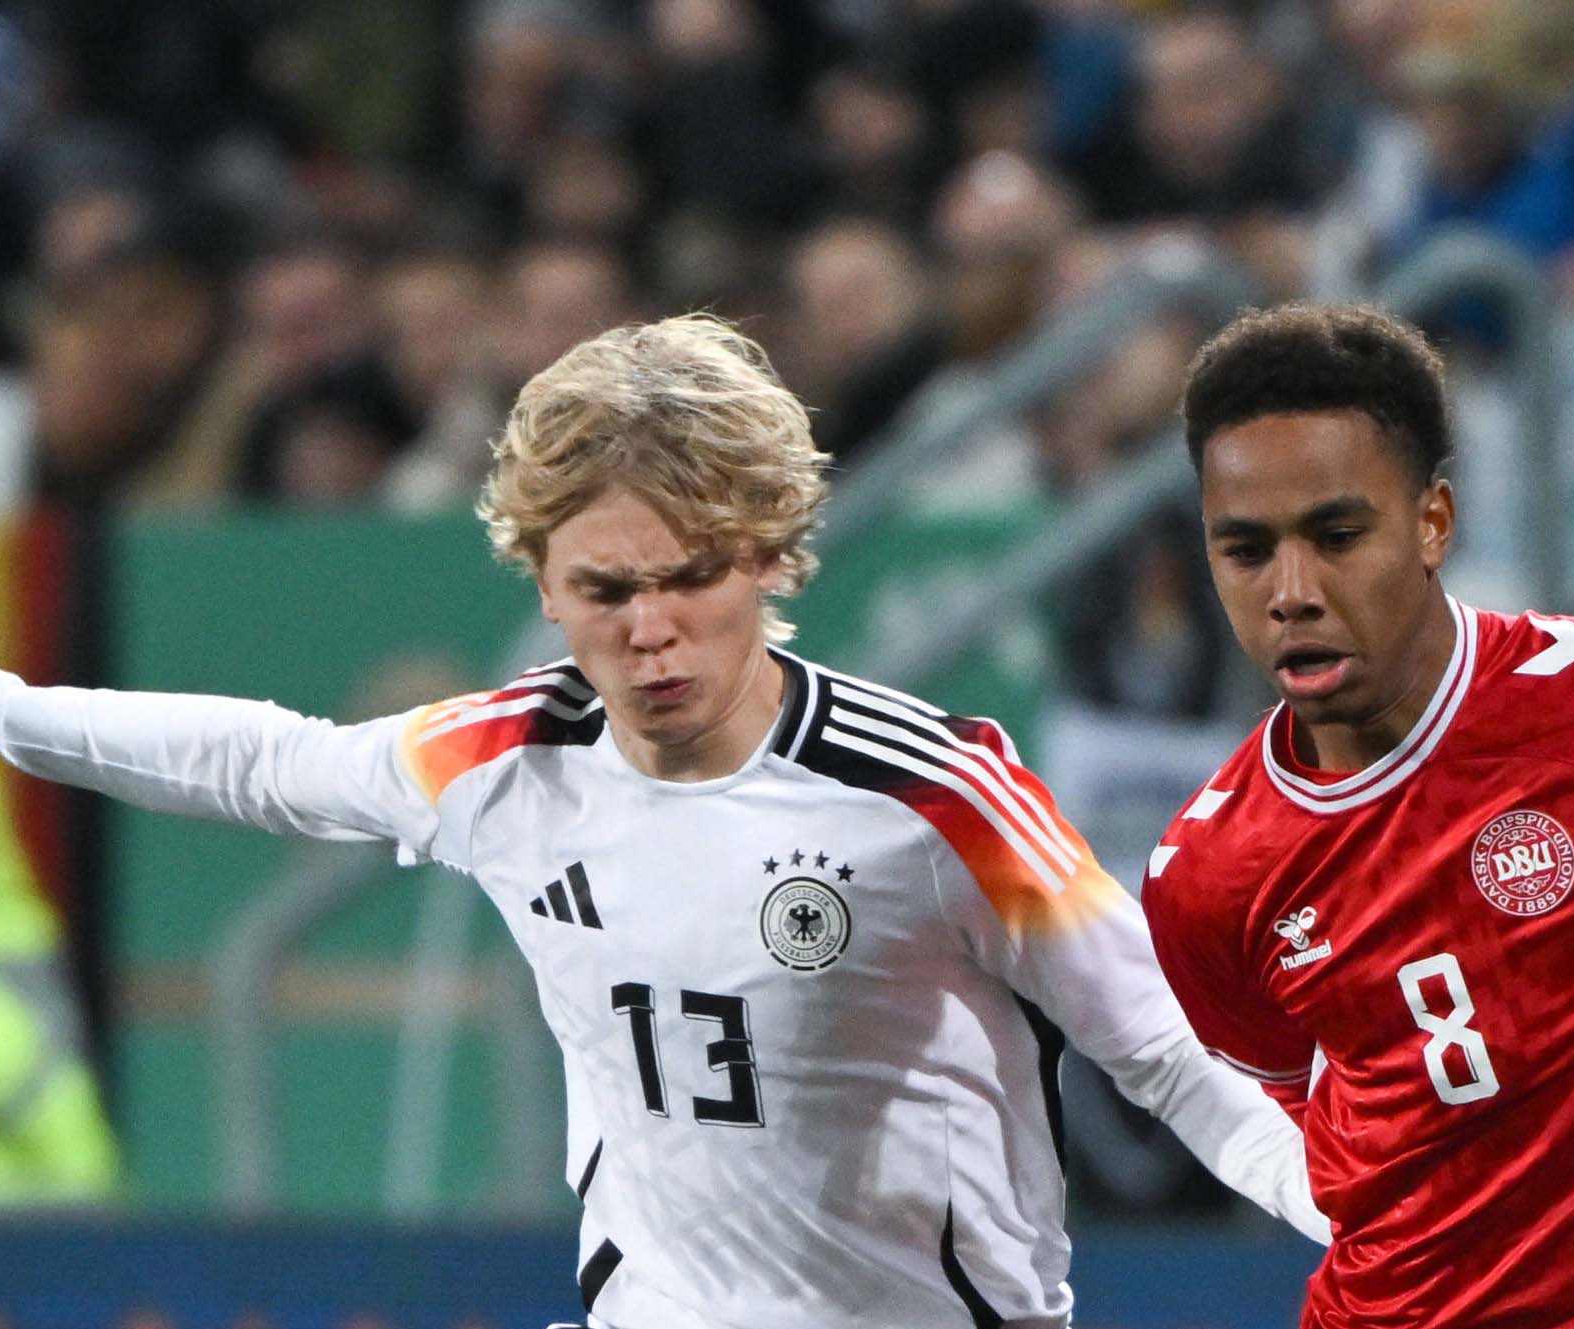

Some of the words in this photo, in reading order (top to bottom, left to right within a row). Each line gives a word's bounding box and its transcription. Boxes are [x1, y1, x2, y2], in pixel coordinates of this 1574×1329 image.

[1475, 851, 1511, 908] DANSK
[1491, 839, 1557, 881] DBU
[1552, 831, 1574, 889] UNION
[778, 888, 831, 907] DEUTSCHER
[1516, 892, 1557, 912] 1889
[1279, 938, 1333, 971] hummel
[1396, 952, 1501, 1106] 8
[611, 982, 766, 1129] 13
